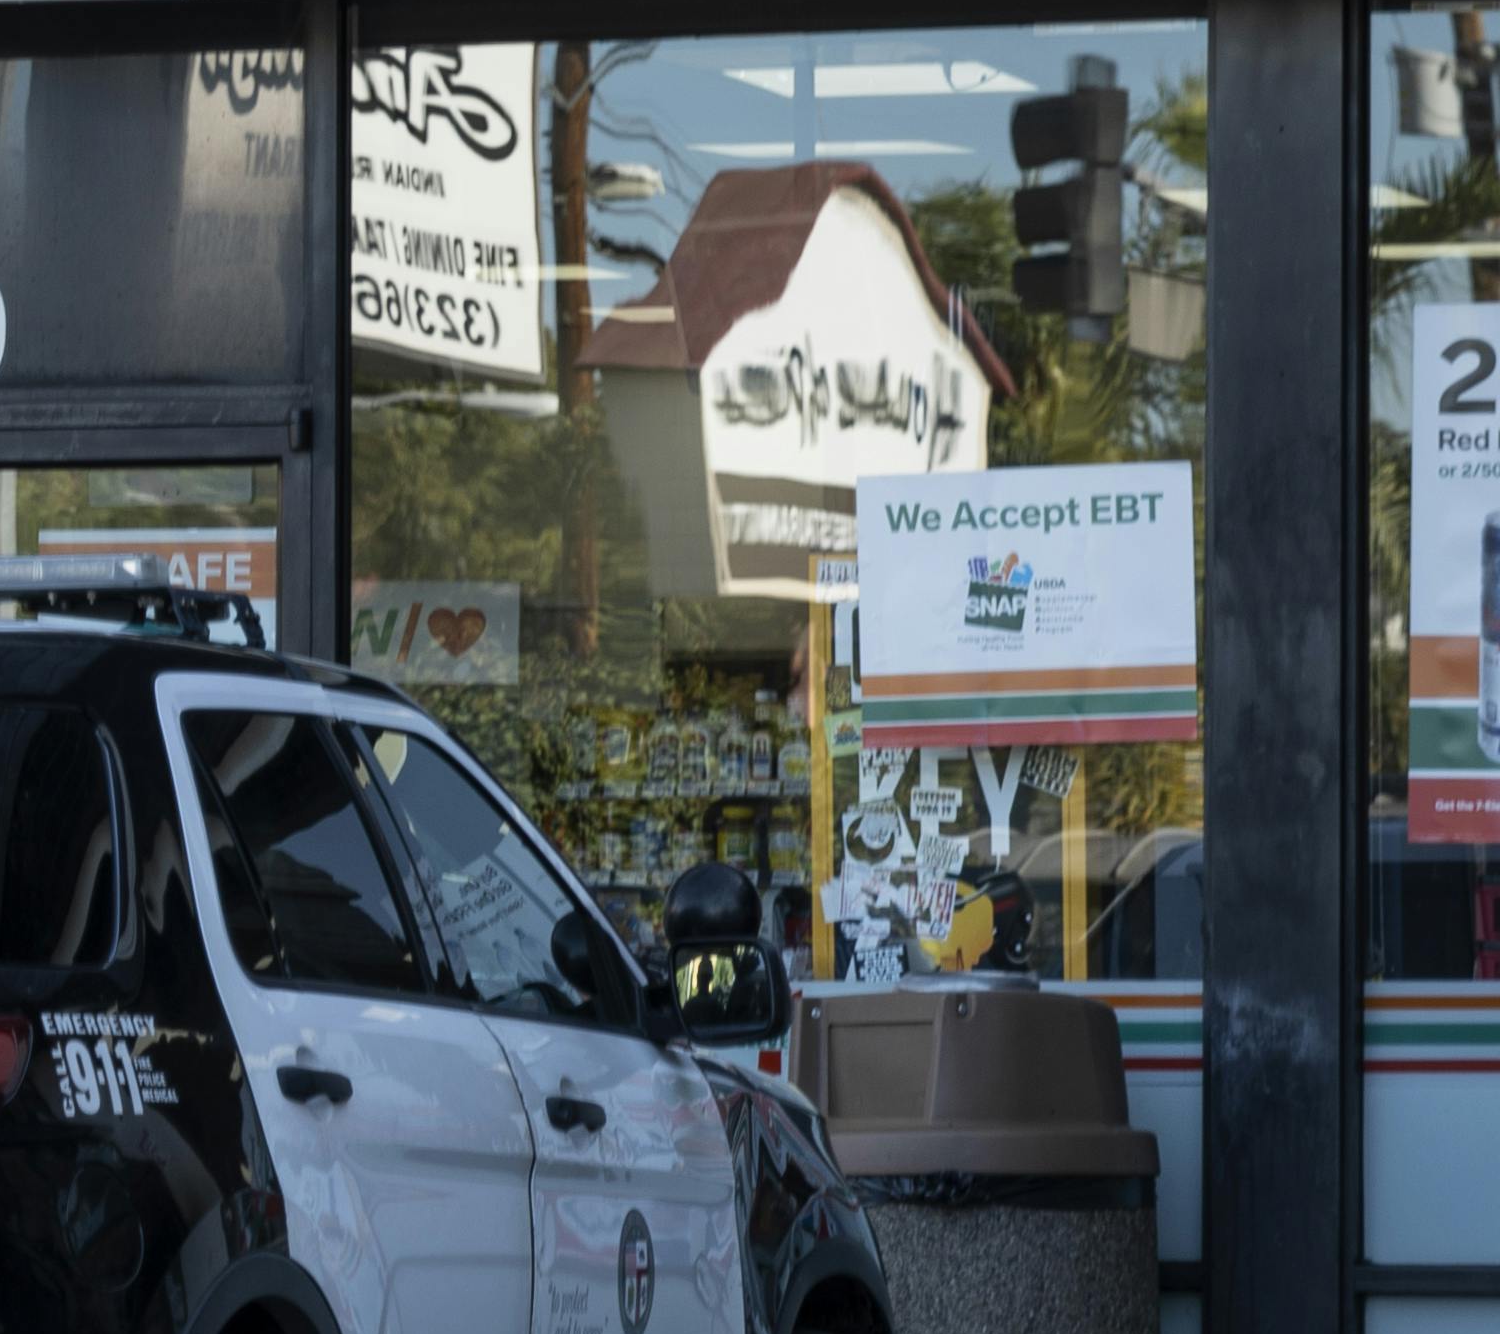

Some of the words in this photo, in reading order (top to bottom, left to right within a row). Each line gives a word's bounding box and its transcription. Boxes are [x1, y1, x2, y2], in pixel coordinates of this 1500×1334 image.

[1438, 338, 1497, 414] 2
[1439, 429, 1490, 451] Red
[1439, 465, 1457, 478] or
[885, 502, 941, 533] We
[952, 497, 1080, 534] Accept
[1090, 492, 1164, 525] EBT
[168, 551, 252, 591] AFE
[1034, 578, 1067, 590] USDA
[965, 594, 1025, 618] SNAP
[40, 1011, 156, 1036] EMERGENCY
[133, 1055, 153, 1071] FIRE
[52, 1040, 76, 1118] CALL
[137, 1072, 167, 1087] POLICE
[141, 1088, 180, 1104] MEDICAL
[560, 1283, 589, 1318] protect
